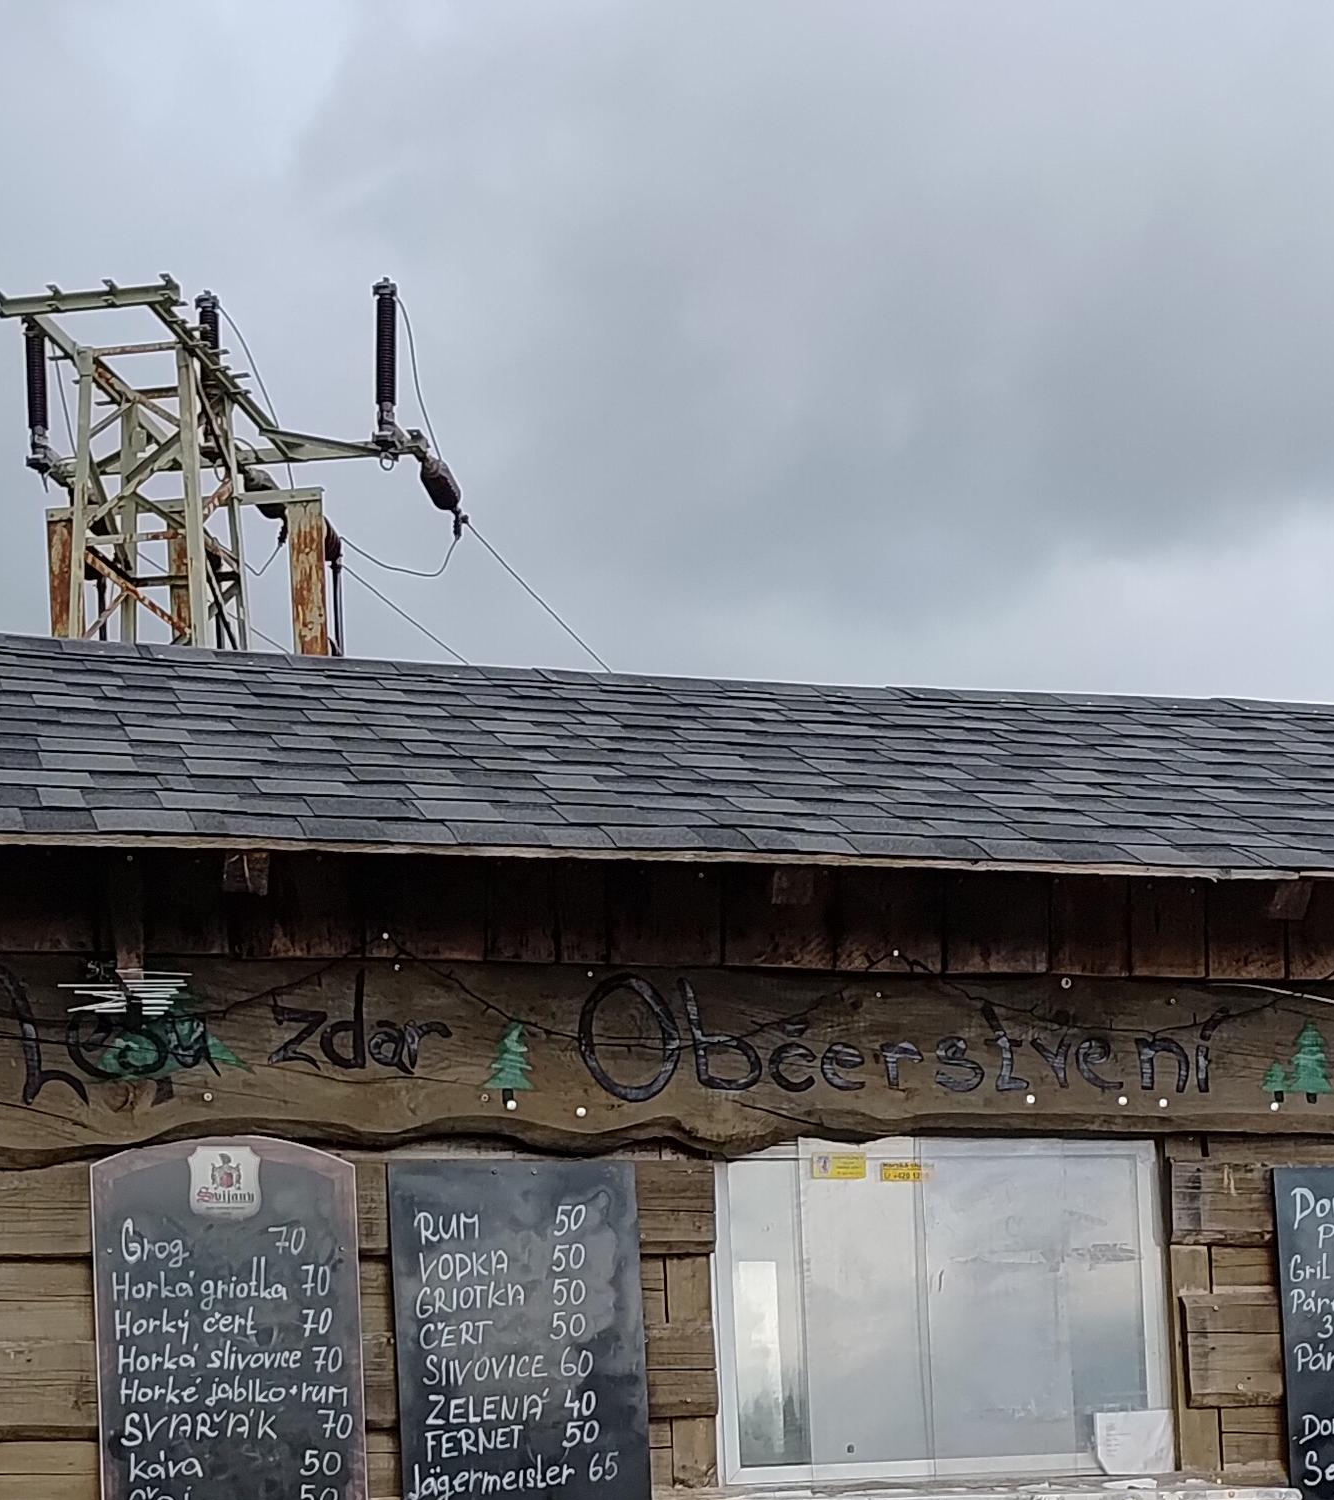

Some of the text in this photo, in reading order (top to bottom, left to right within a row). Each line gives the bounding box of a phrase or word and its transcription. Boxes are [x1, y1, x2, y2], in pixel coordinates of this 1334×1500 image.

[267, 967, 453, 1075] zdar
[121, 1218, 307, 1267] Grog 70
[414, 1204, 587, 1245] RUM 50
[418, 1243, 586, 1283] VODKA 50
[112, 1256, 331, 1311] Horká griotka 70
[416, 1278, 586, 1318] GRIOTKA 50
[114, 1306, 333, 1345] Horký čert 70
[419, 1312, 586, 1350] ČERT 50
[1317, 1315, 1333, 1339] 3
[117, 1340, 343, 1374] Horká slivovice 70
[560, 1346, 594, 1378] 60
[120, 1377, 202, 1404] Horké
[425, 1387, 596, 1425] ZELENÁ 40
[120, 1409, 353, 1446] SVAŘÁK 70
[425, 1419, 600, 1462] FERNET 50
[300, 1450, 342, 1476] 50
[588, 1451, 619, 1482] 65
